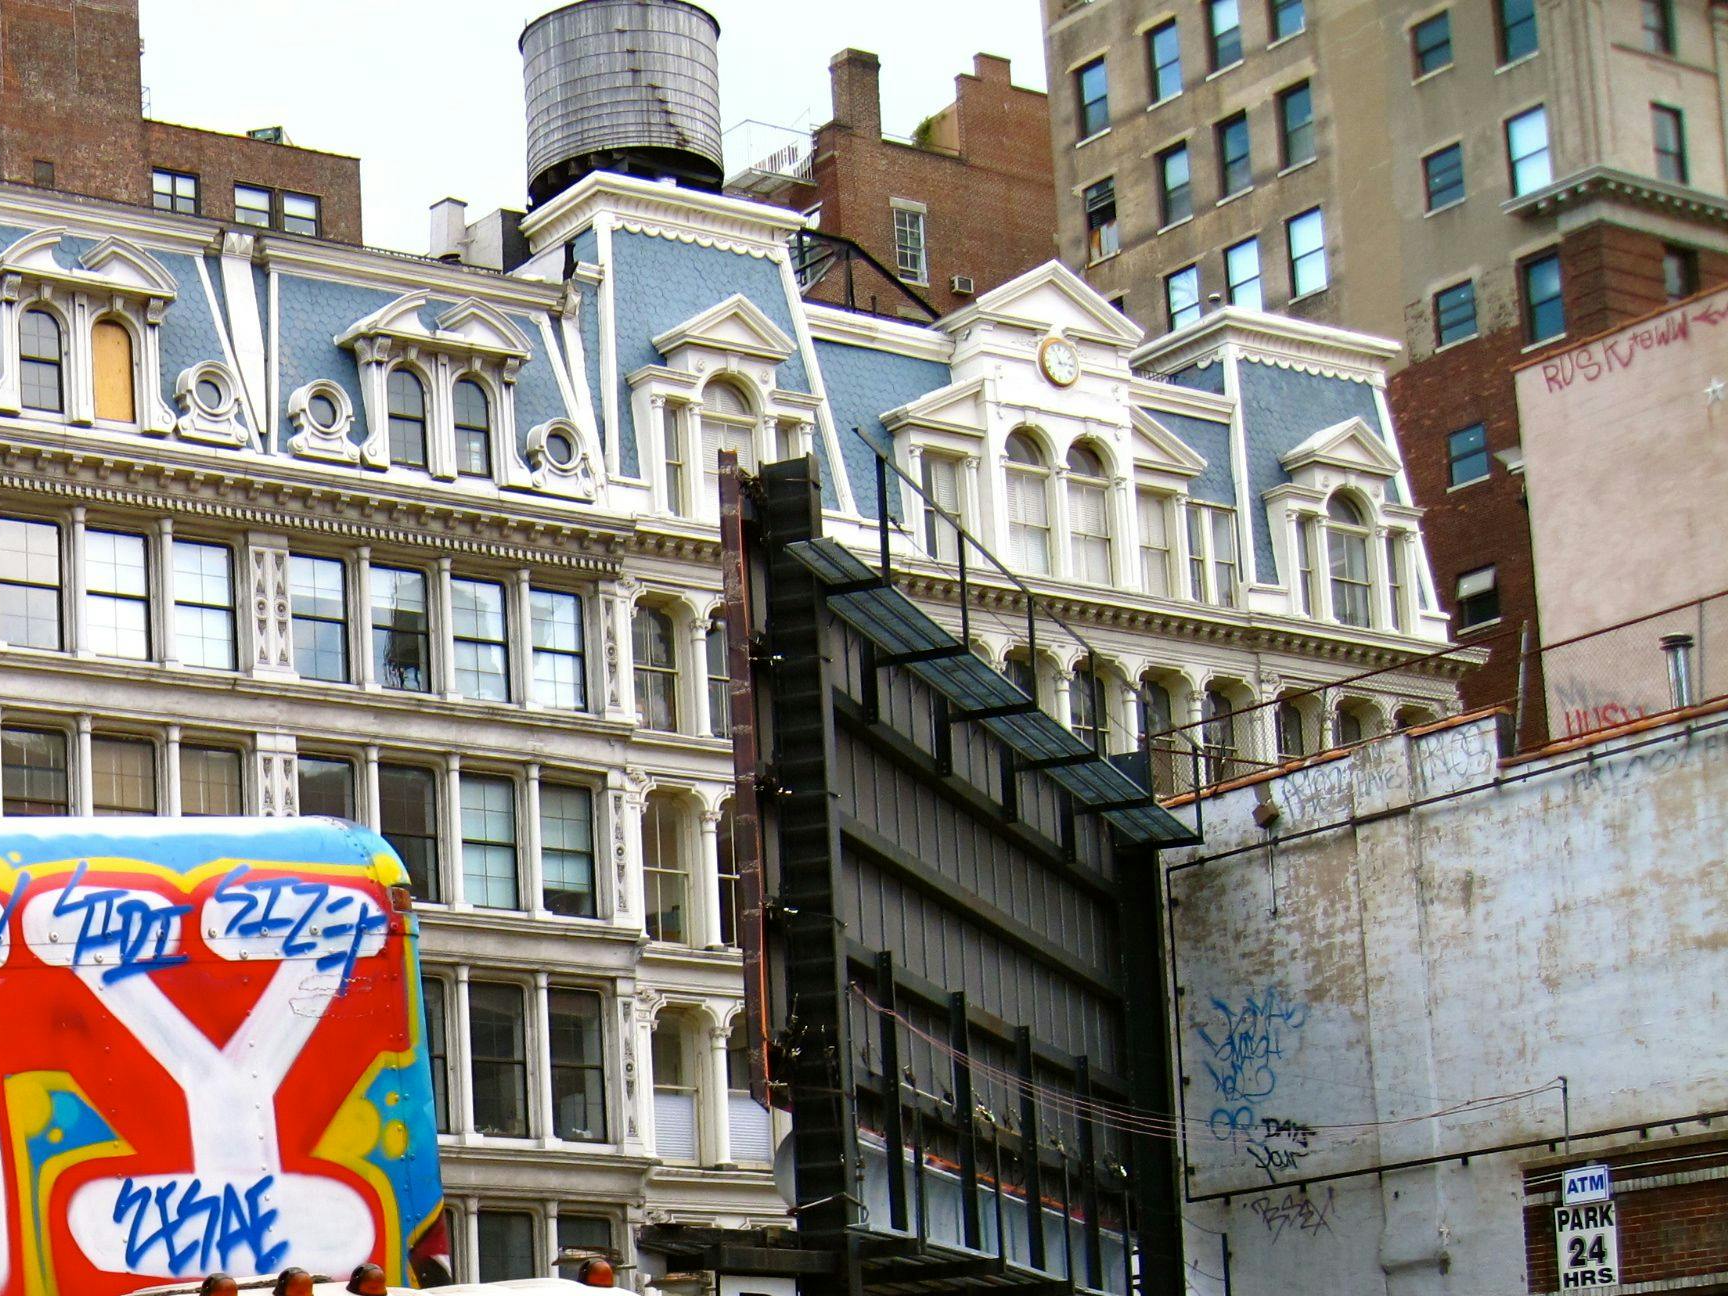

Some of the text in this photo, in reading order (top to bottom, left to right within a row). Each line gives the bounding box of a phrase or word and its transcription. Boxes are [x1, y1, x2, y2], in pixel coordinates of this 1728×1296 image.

[1567, 1173, 1604, 1195] ATM
[1557, 1203, 1614, 1232] PARK
[1568, 1233, 1607, 1268] 24
